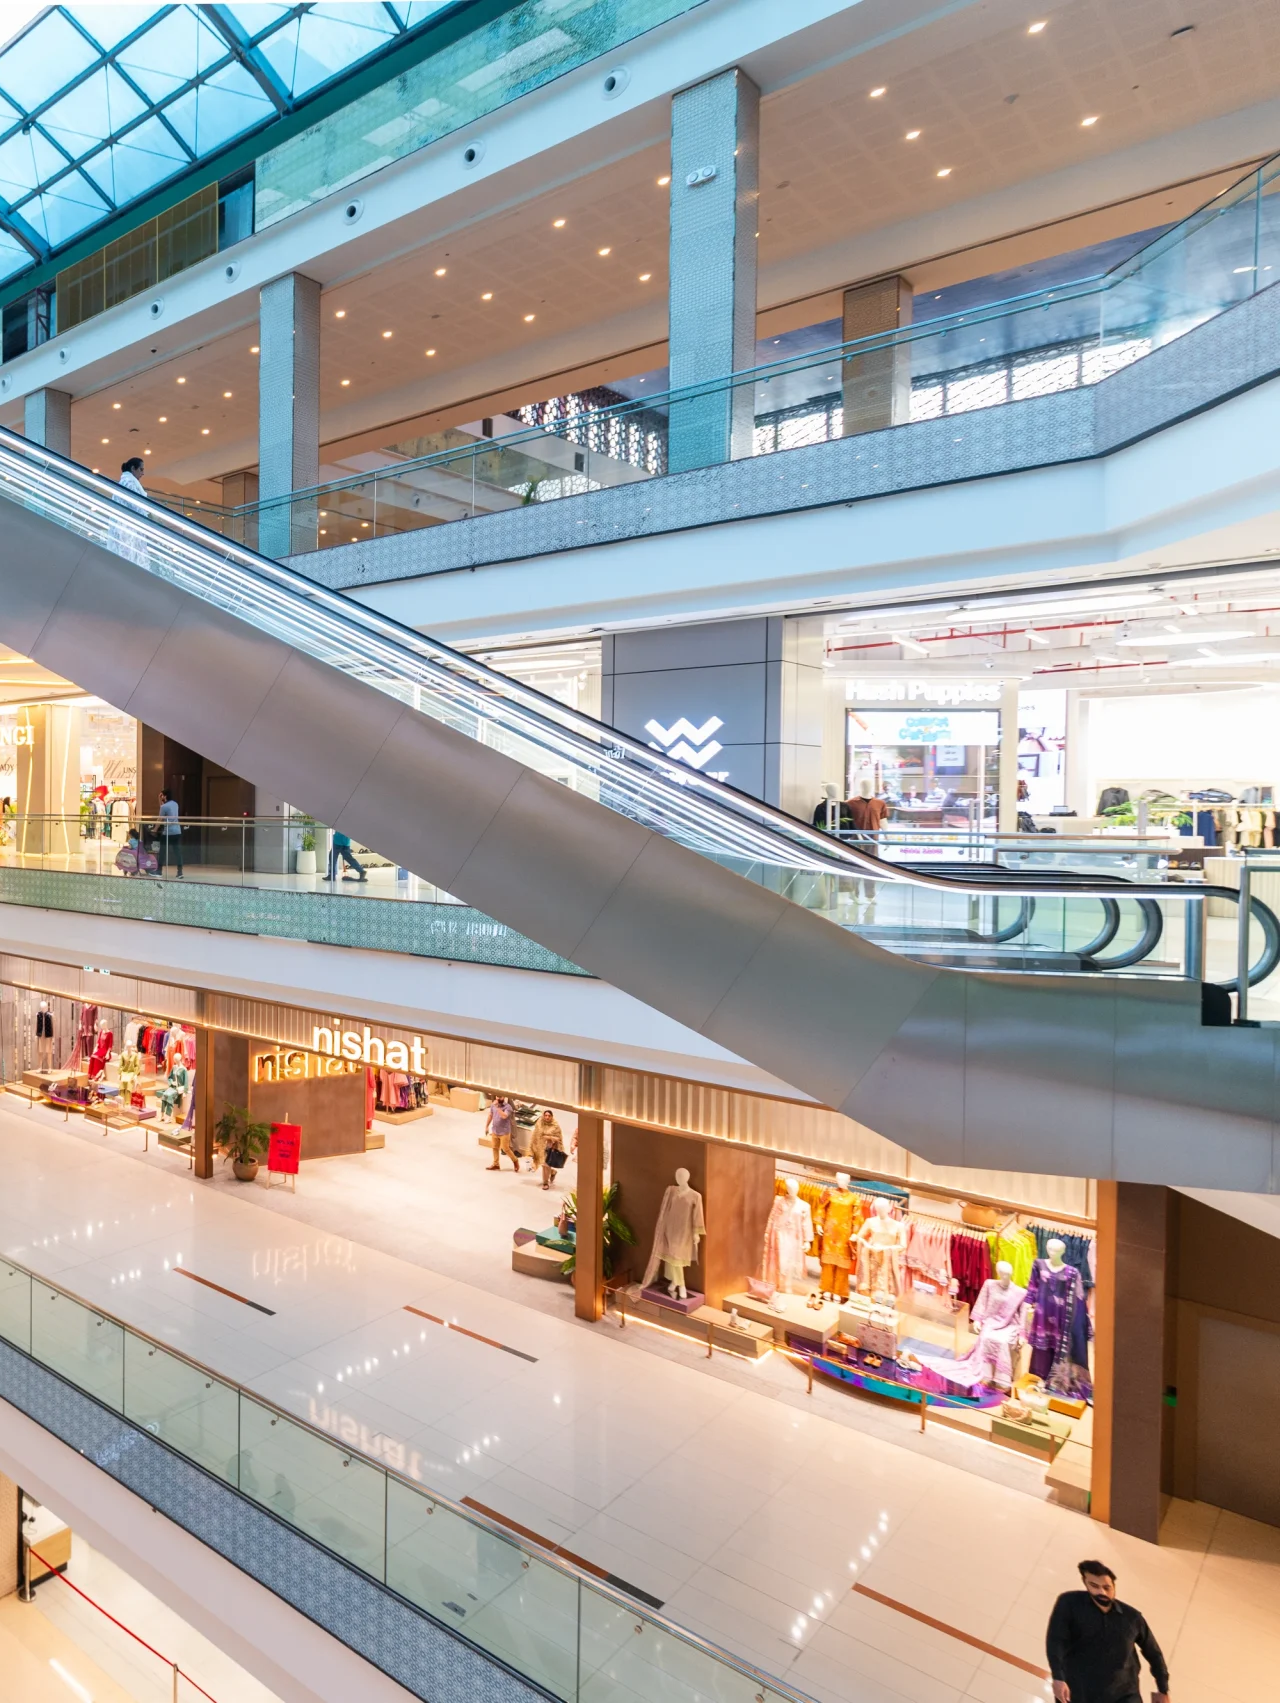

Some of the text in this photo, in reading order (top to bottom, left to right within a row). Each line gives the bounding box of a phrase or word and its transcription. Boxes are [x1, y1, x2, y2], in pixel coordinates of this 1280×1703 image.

[846, 680, 1001, 705] Hush Puppies
[312, 1018, 426, 1076] nishat
